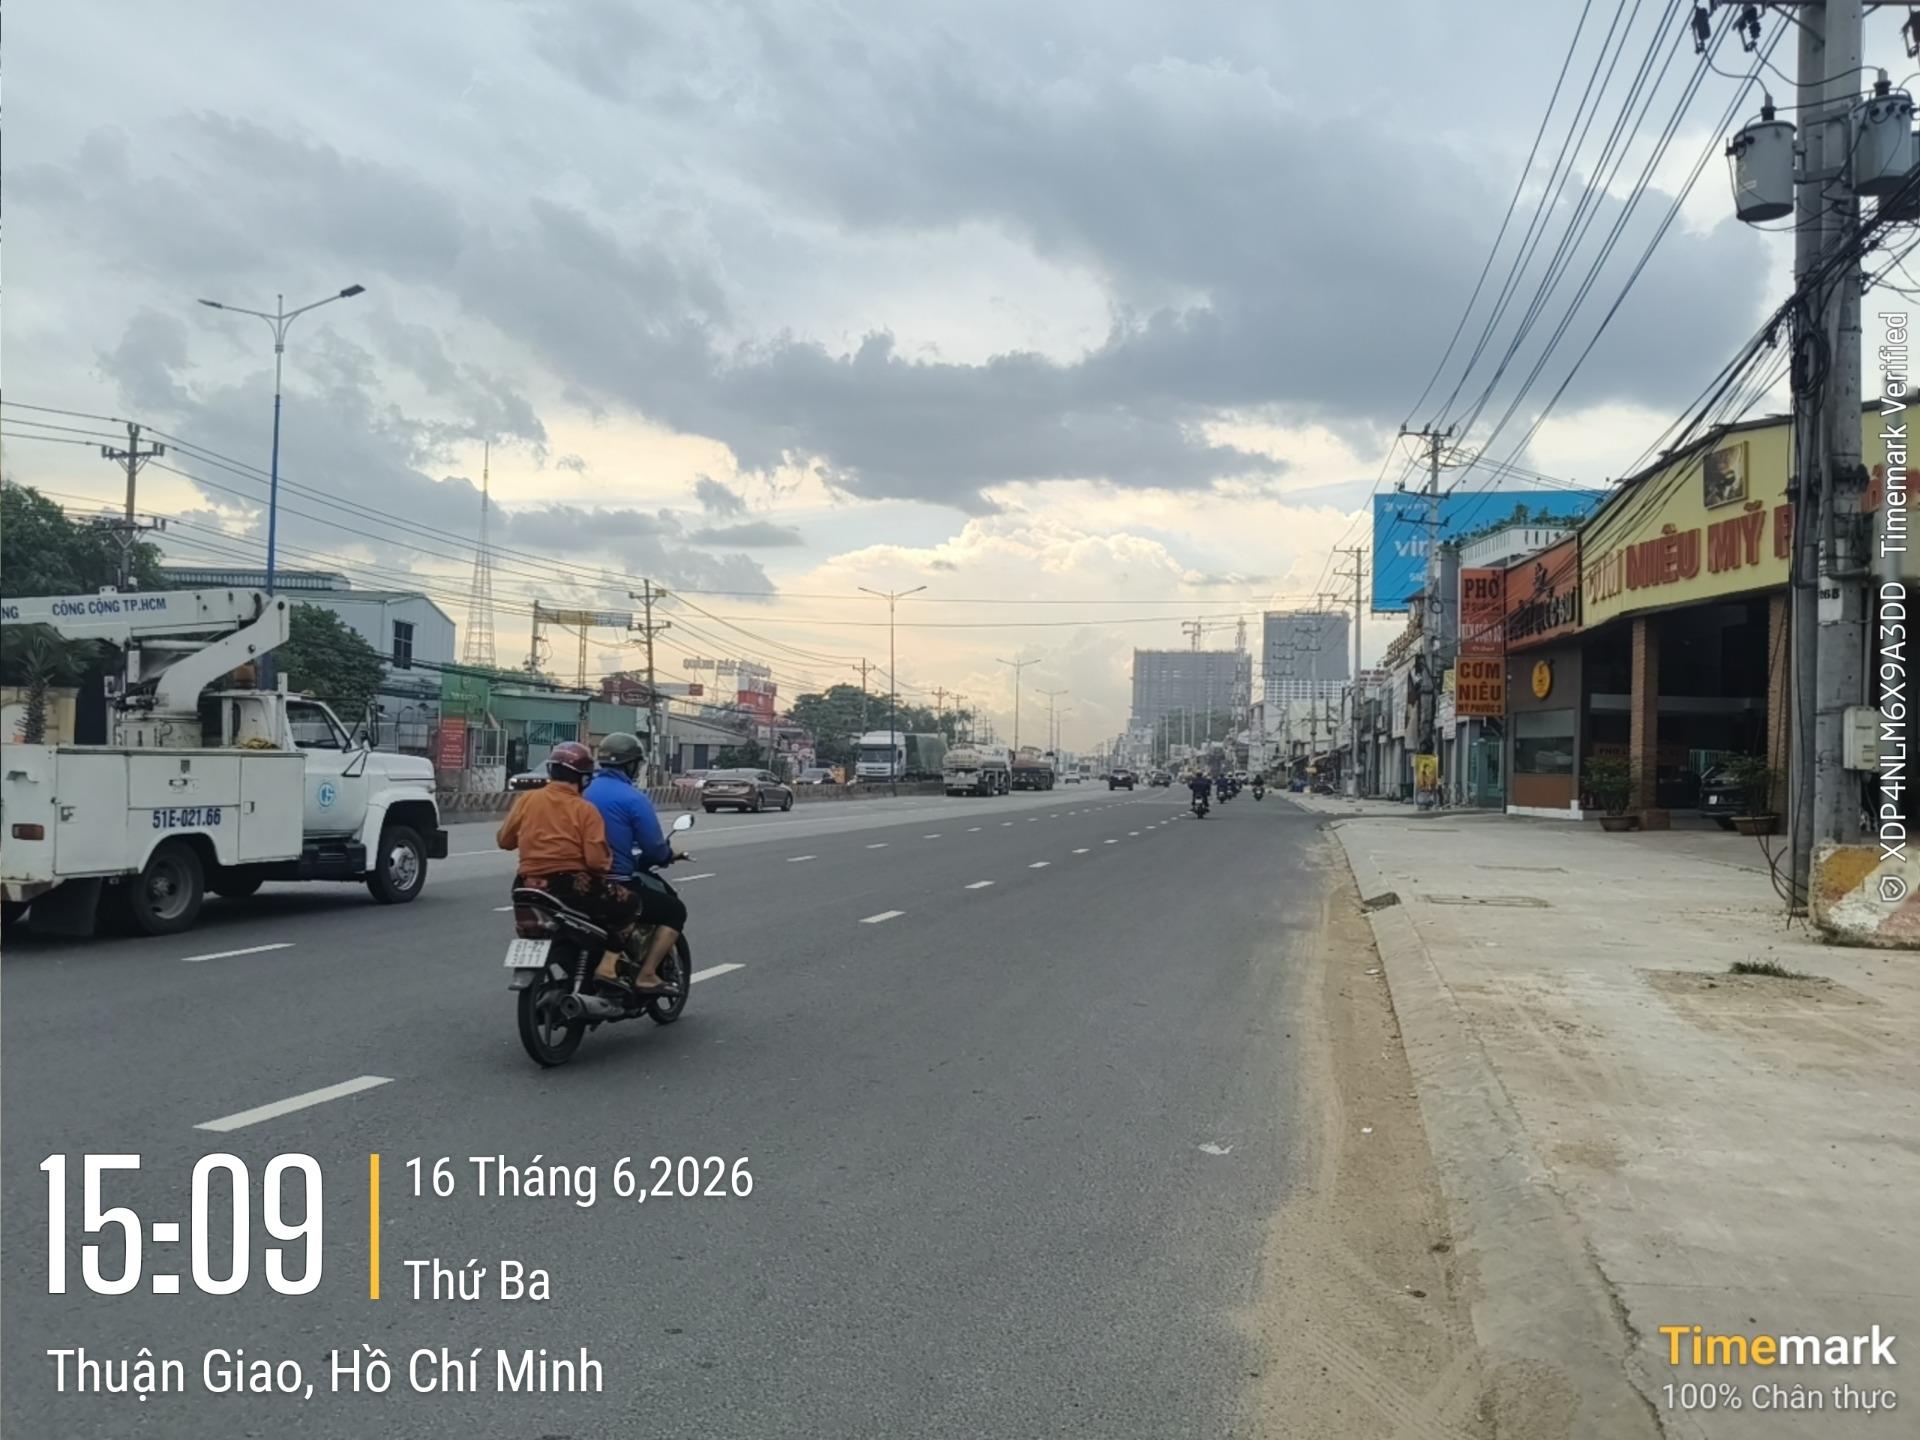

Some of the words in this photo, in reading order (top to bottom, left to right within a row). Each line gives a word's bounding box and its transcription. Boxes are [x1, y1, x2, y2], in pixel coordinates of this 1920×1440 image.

[1707, 499, 1767, 574] MỸ
[1464, 570, 1500, 599] PHỞ
[52, 600, 86, 616] CÔNG
[88, 599, 121, 617] CỘNG
[123, 598, 167, 612] TP.HCM
[1460, 661, 1500, 679] CƠM
[1458, 681, 1501, 701] NIÊU
[152, 808, 221, 829] 51E-021.66
